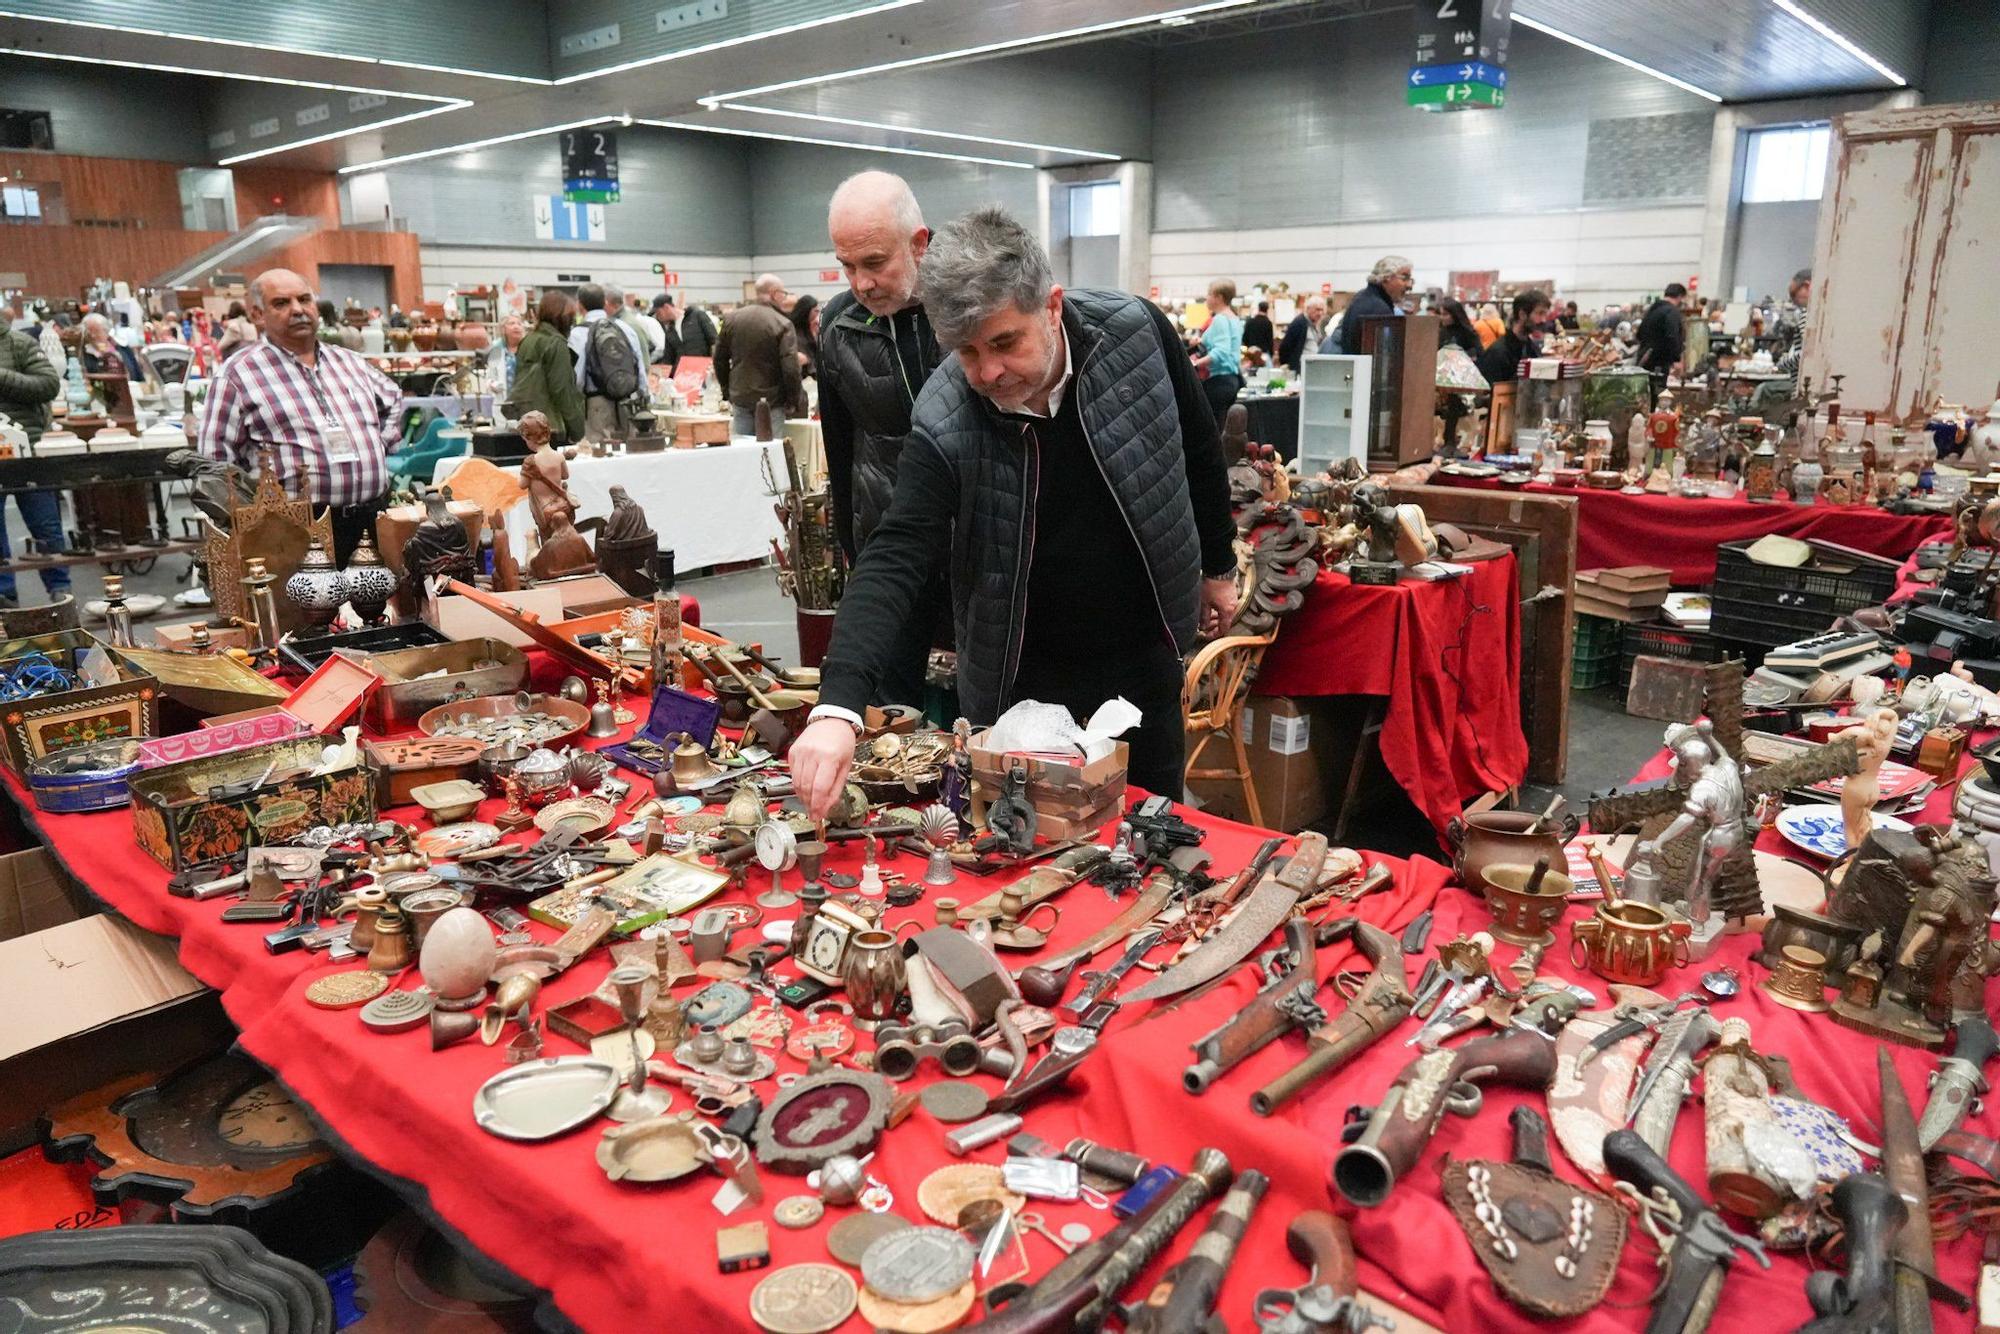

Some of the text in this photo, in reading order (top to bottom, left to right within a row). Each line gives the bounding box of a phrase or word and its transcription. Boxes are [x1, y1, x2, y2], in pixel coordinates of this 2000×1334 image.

[567, 133, 577, 156] 2
[593, 133, 606, 156] 2
[562, 202, 580, 239] 1
